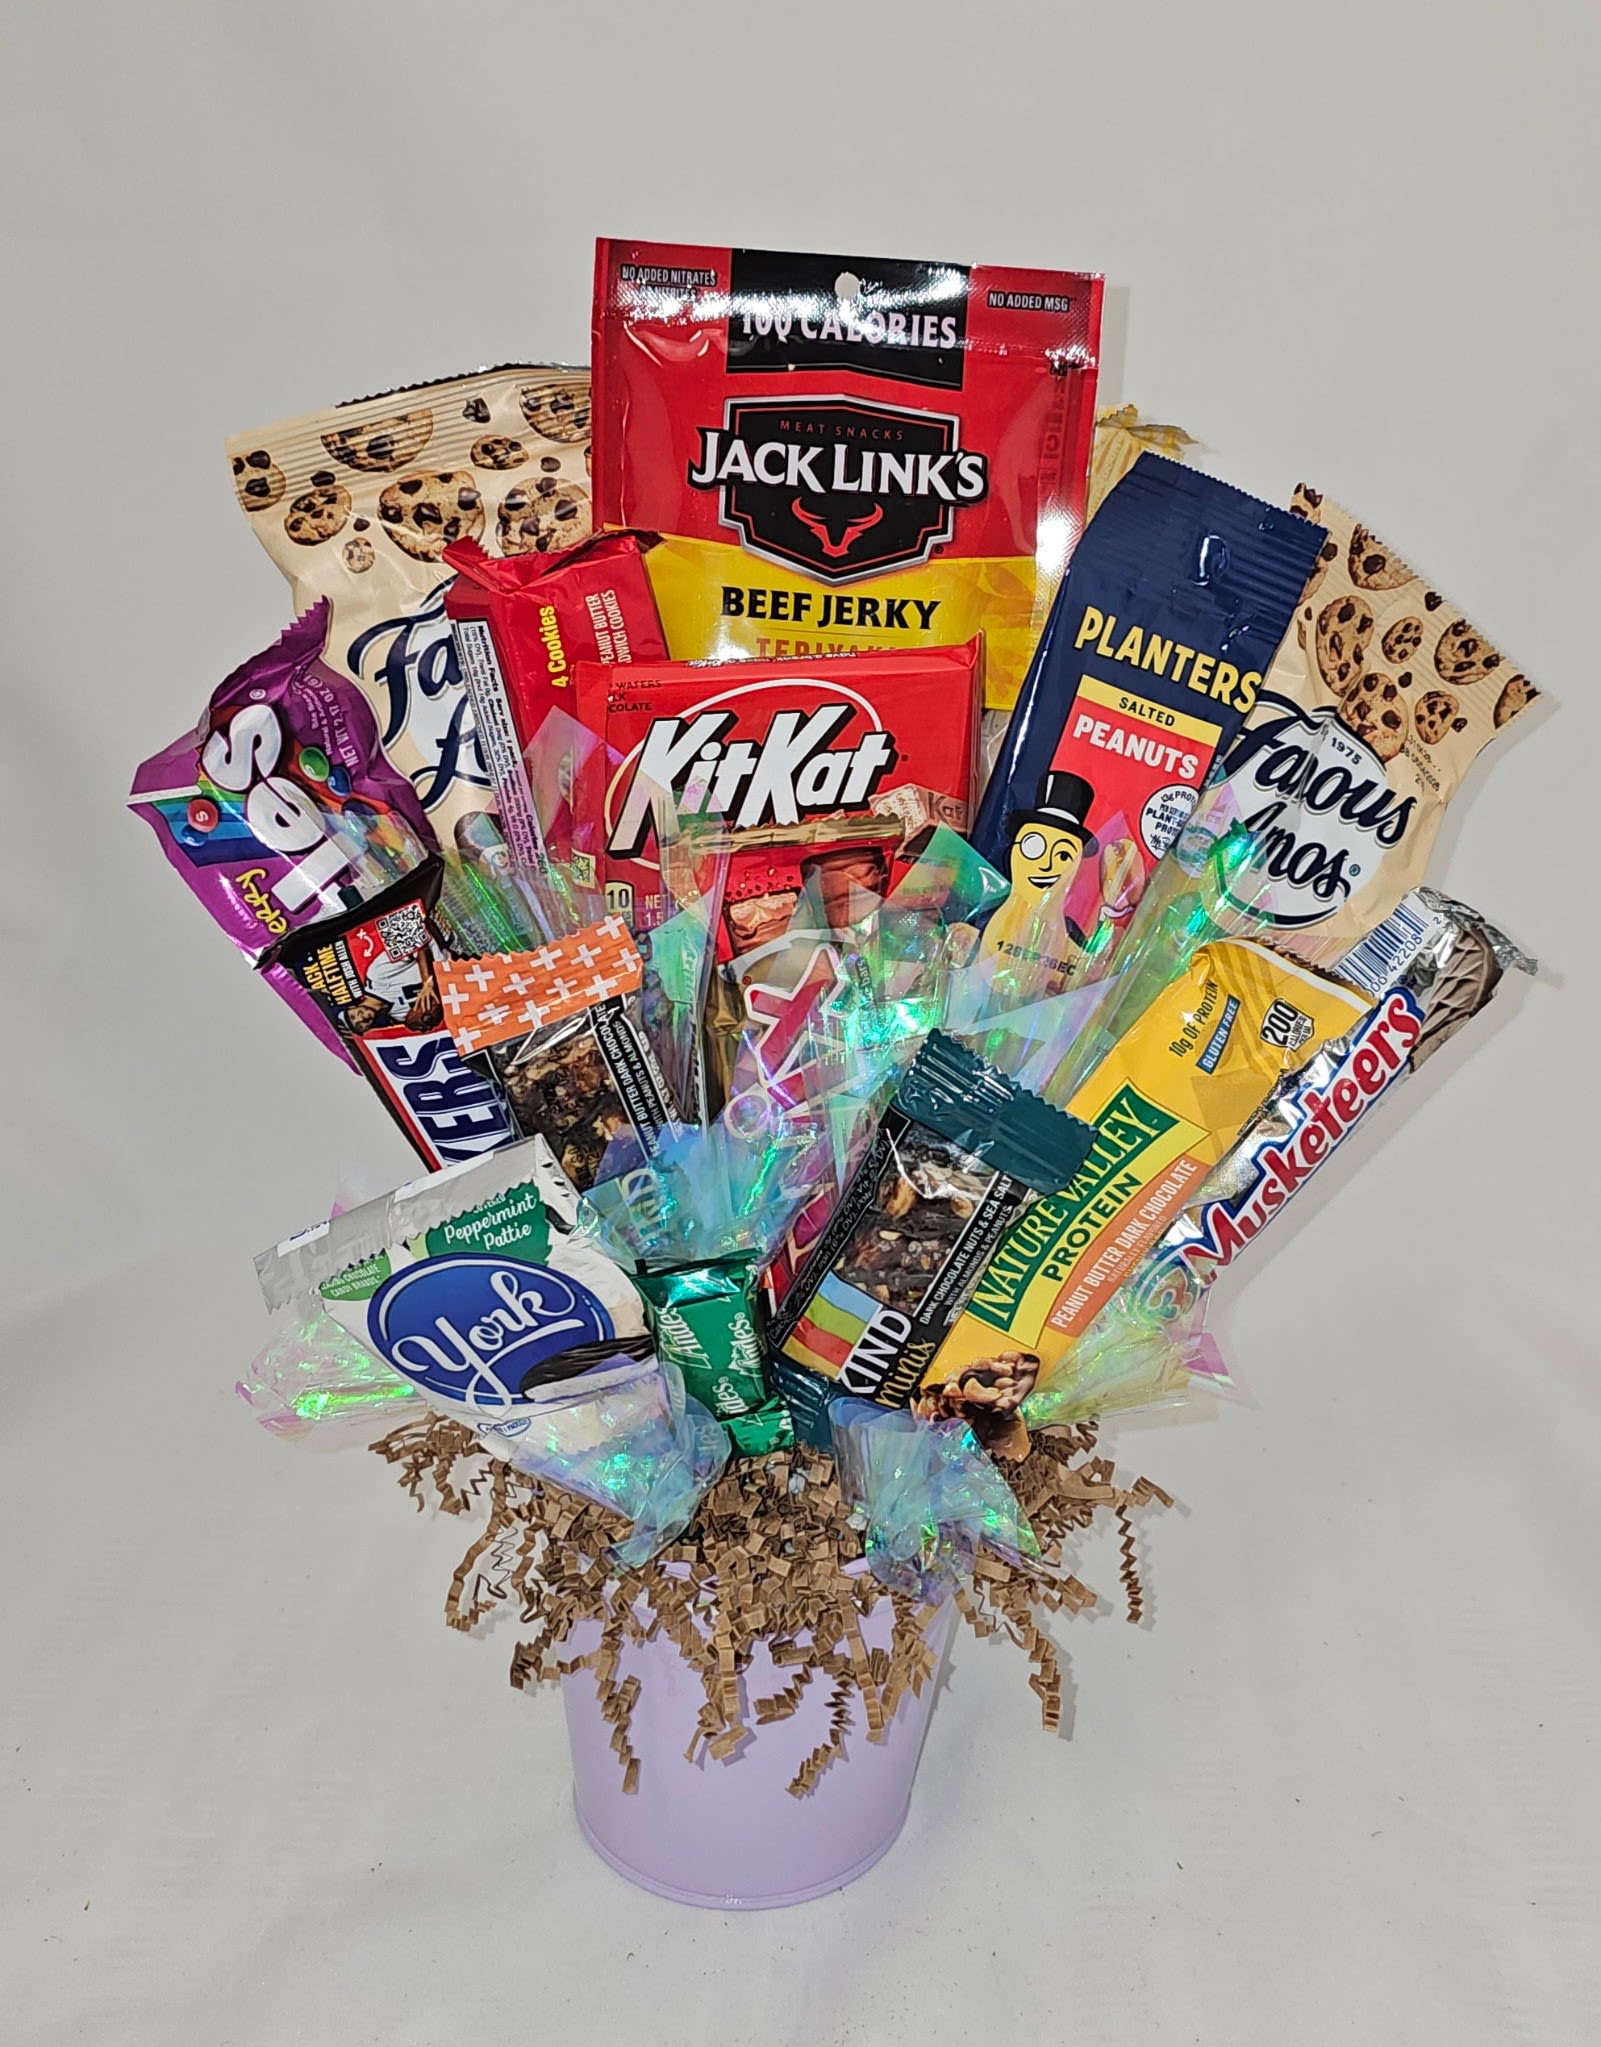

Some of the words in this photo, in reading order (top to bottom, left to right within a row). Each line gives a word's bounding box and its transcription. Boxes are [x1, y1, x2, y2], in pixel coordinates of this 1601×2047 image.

[622, 266, 635, 279] NO
[638, 268, 669, 281] ADDED
[671, 270, 715, 285] NITRATES
[989, 293, 1004, 306] NO
[1007, 294, 1041, 309] ADDED
[1044, 296, 1068, 311] MSG
[741, 309, 793, 339] 100
[799, 309, 957, 349] CALORIES
[780, 419, 827, 435] MEAT
[835, 423, 905, 441] SNACKS
[691, 431, 825, 494] JACK
[833, 443, 986, 502] LINK'S
[585, 594, 608, 630] BUTTER
[601, 589, 624, 630] COOKIES
[720, 586, 813, 623] BEEF
[816, 594, 942, 630] JERKY
[539, 606, 566, 673] Cookies
[597, 632, 615, 665] PEANUT
[1073, 606, 1262, 714] PLANTERS
[318, 686, 335, 703] OZ
[552, 675, 569, 688] 4
[616, 680, 662, 690] WAFERS
[325, 703, 346, 727] 2.17
[608, 703, 652, 713] COLATE
[1118, 696, 1176, 728] SALTED
[332, 725, 350, 745] WT
[338, 742, 360, 767] NET
[1072, 714, 1200, 781] PEANUTS
[1330, 737, 1362, 765] 1975
[608, 704, 894, 853] KitKat
[234, 868, 287, 935] erry
[645, 895, 661, 909] NE
[333, 938, 349, 960] ALLEN
[341, 959, 356, 979] JOSH
[1385, 931, 1423, 975] 42208
[316, 940, 353, 1007] HALFTIME
[348, 977, 363, 998] WITH
[1187, 978, 1224, 1025] PROTEIN
[590, 1002, 625, 1060] CHOCOLATE
[611, 1018, 639, 1063] ALMONDS
[1180, 1020, 1202, 1040] OF
[1200, 1026, 1230, 1069] GLUTEN
[1217, 998, 1241, 1028] FREE
[1259, 999, 1301, 1047] 200
[1167, 1034, 1194, 1060] 10g
[614, 1057, 633, 1086] DARK
[634, 1069, 657, 1108] PEANUTS
[625, 1085, 648, 1121] BUTTER
[1183, 996, 1422, 1287] Musketeers
[444, 1193, 538, 1244] Peppermint
[972, 1207, 1068, 1321] NATURE
[1065, 1108, 1160, 1205] VALLEY
[1042, 1172, 1143, 1282] PROTEIN
[482, 1222, 533, 1252] Pattie
[918, 1298, 940, 1325] DARK
[933, 1249, 970, 1303] CHOCOLATE
[962, 1226, 984, 1253] NUTS
[981, 1197, 1001, 1220] SEA
[993, 1174, 1014, 1200] SALT
[944, 1285, 961, 1308] WITH
[957, 1248, 985, 1289] ALMONDS
[983, 1202, 1013, 1245] PEANUTS
[1052, 1283, 1094, 1330] PEANUT
[1084, 1244, 1126, 1288] BUTTER
[1113, 1214, 1149, 1253] DARK
[1143, 1159, 1198, 1226] CHOCOLATE
[1106, 1245, 1140, 1285] NATURALLY
[1136, 1212, 1167, 1249] FLAVORED
[391, 1271, 576, 1415] York
[838, 1305, 912, 1394] KIND
[875, 1338, 937, 1409] minis
